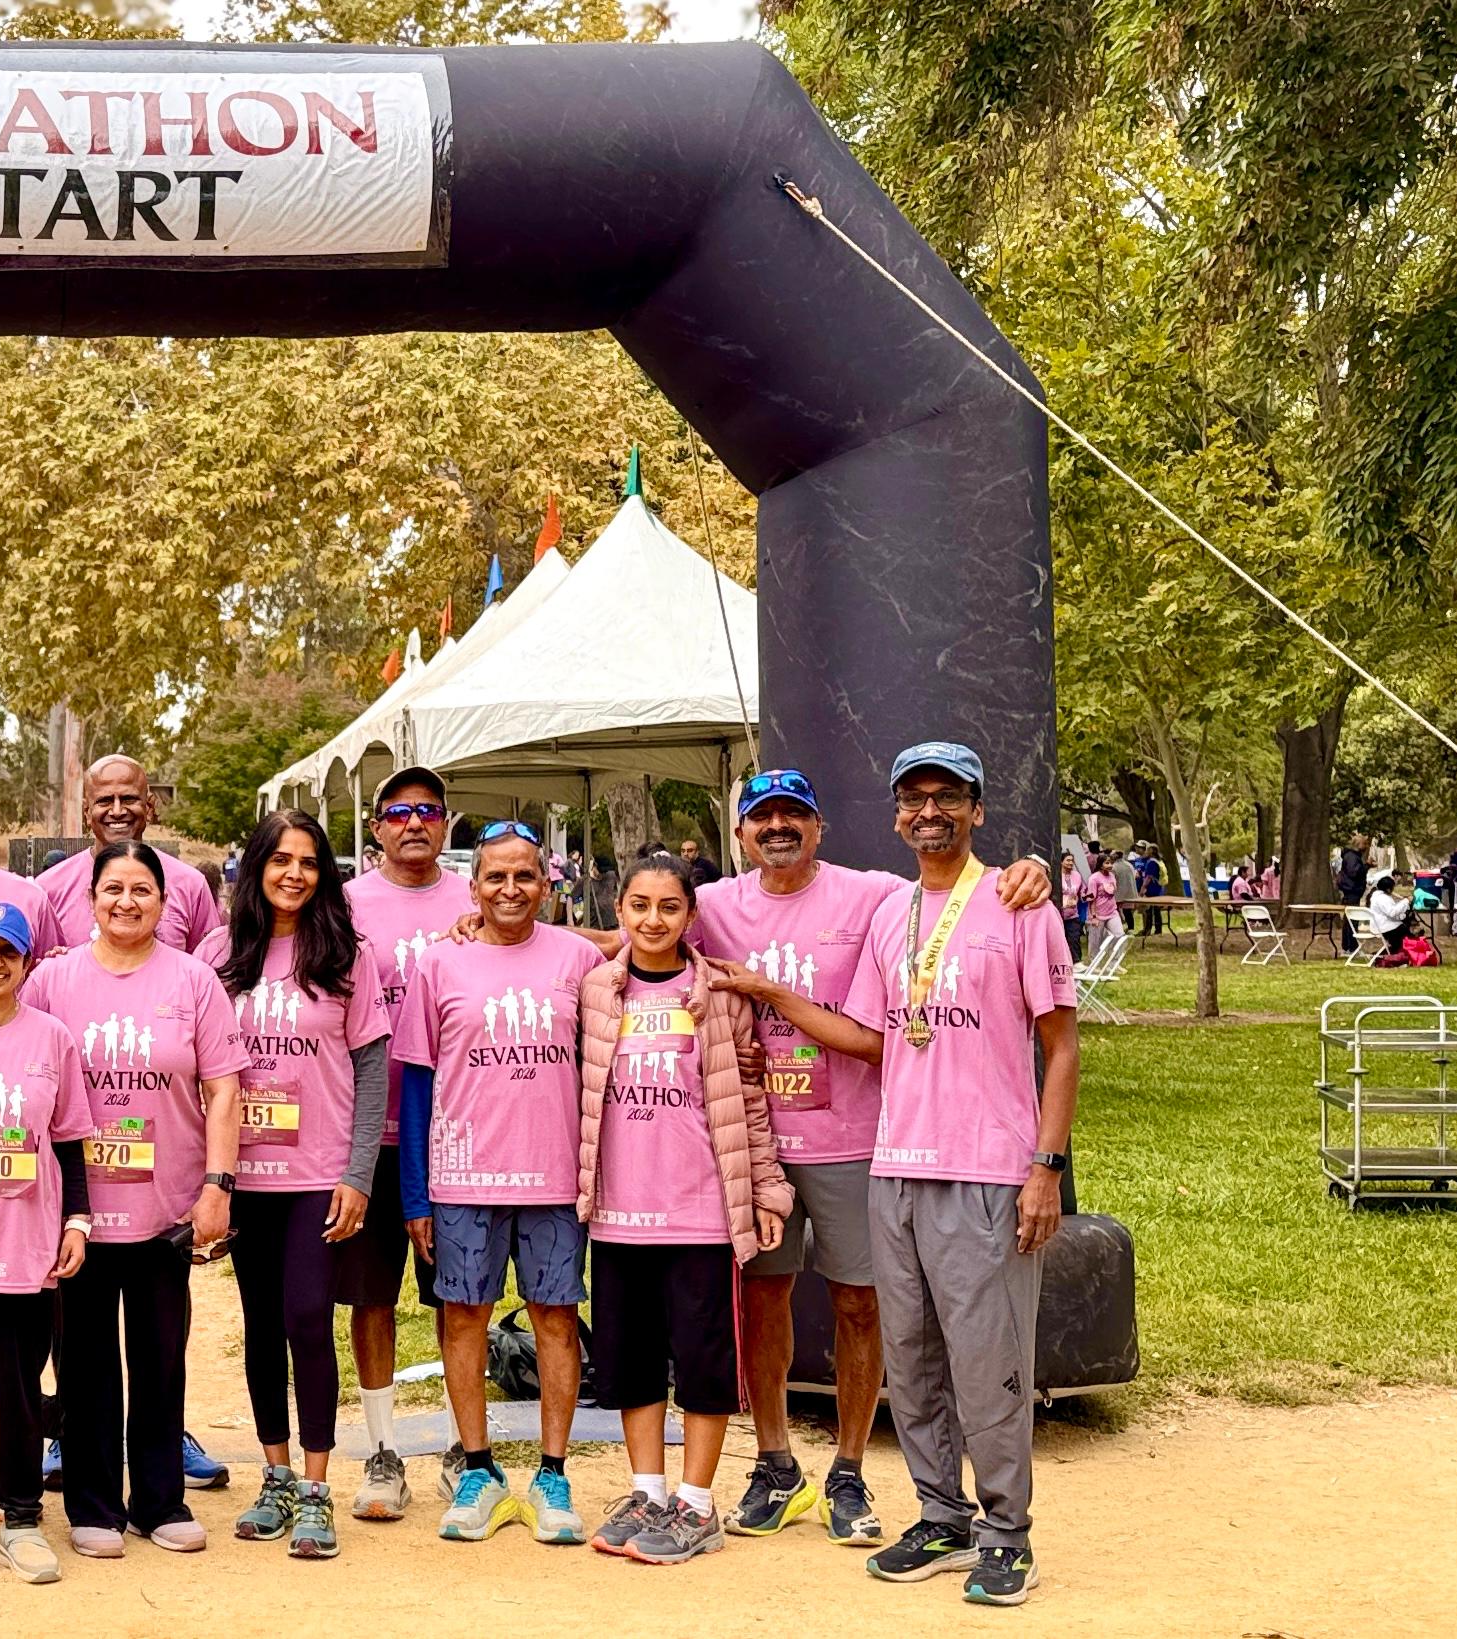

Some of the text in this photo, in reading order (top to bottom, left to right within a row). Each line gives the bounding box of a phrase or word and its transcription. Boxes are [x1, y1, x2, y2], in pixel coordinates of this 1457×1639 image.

[924, 899, 962, 972] ICC SEVATHON
[632, 1012, 671, 1033] 280
[768, 1024, 795, 1037] 2026
[252, 1058, 278, 1071] 2026
[468, 1044, 571, 1067] SEVATHON
[82, 1070, 173, 1091] VATHON
[510, 1067, 537, 1081] 2026
[104, 1092, 131, 1106] 2026
[604, 1085, 693, 1110] EVATHON
[241, 1104, 275, 1126] 151
[626, 1107, 655, 1121] 2026
[93, 1143, 131, 1165] 370
[441, 1172, 545, 1187] CELEBRATE
